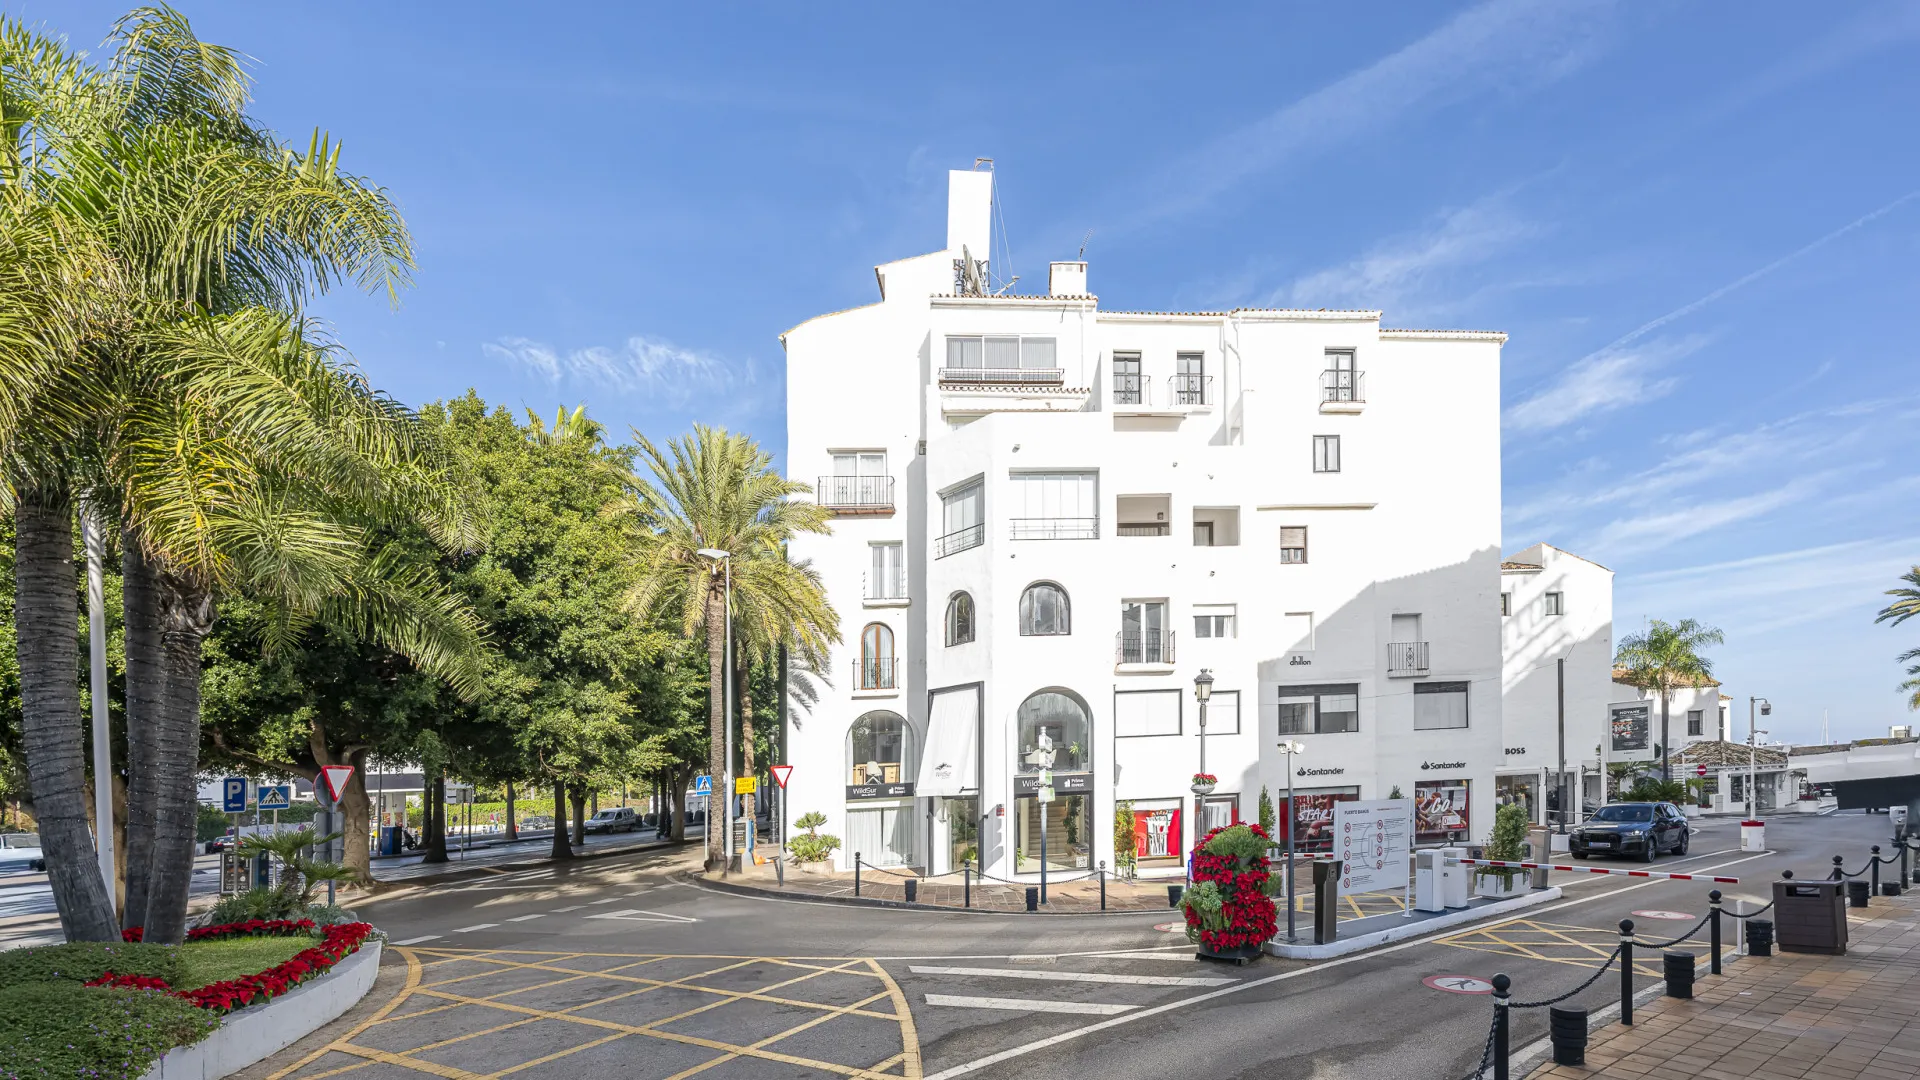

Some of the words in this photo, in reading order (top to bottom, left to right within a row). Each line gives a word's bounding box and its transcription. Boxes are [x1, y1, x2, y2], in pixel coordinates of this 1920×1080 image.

[1289, 655, 1311, 666] dhillon
[1505, 747, 1526, 755] BOSS
[1430, 761, 1466, 770] Santander
[1307, 768, 1345, 776] Santander
[228, 781, 242, 800] P
[852, 787, 877, 795] WildSur
